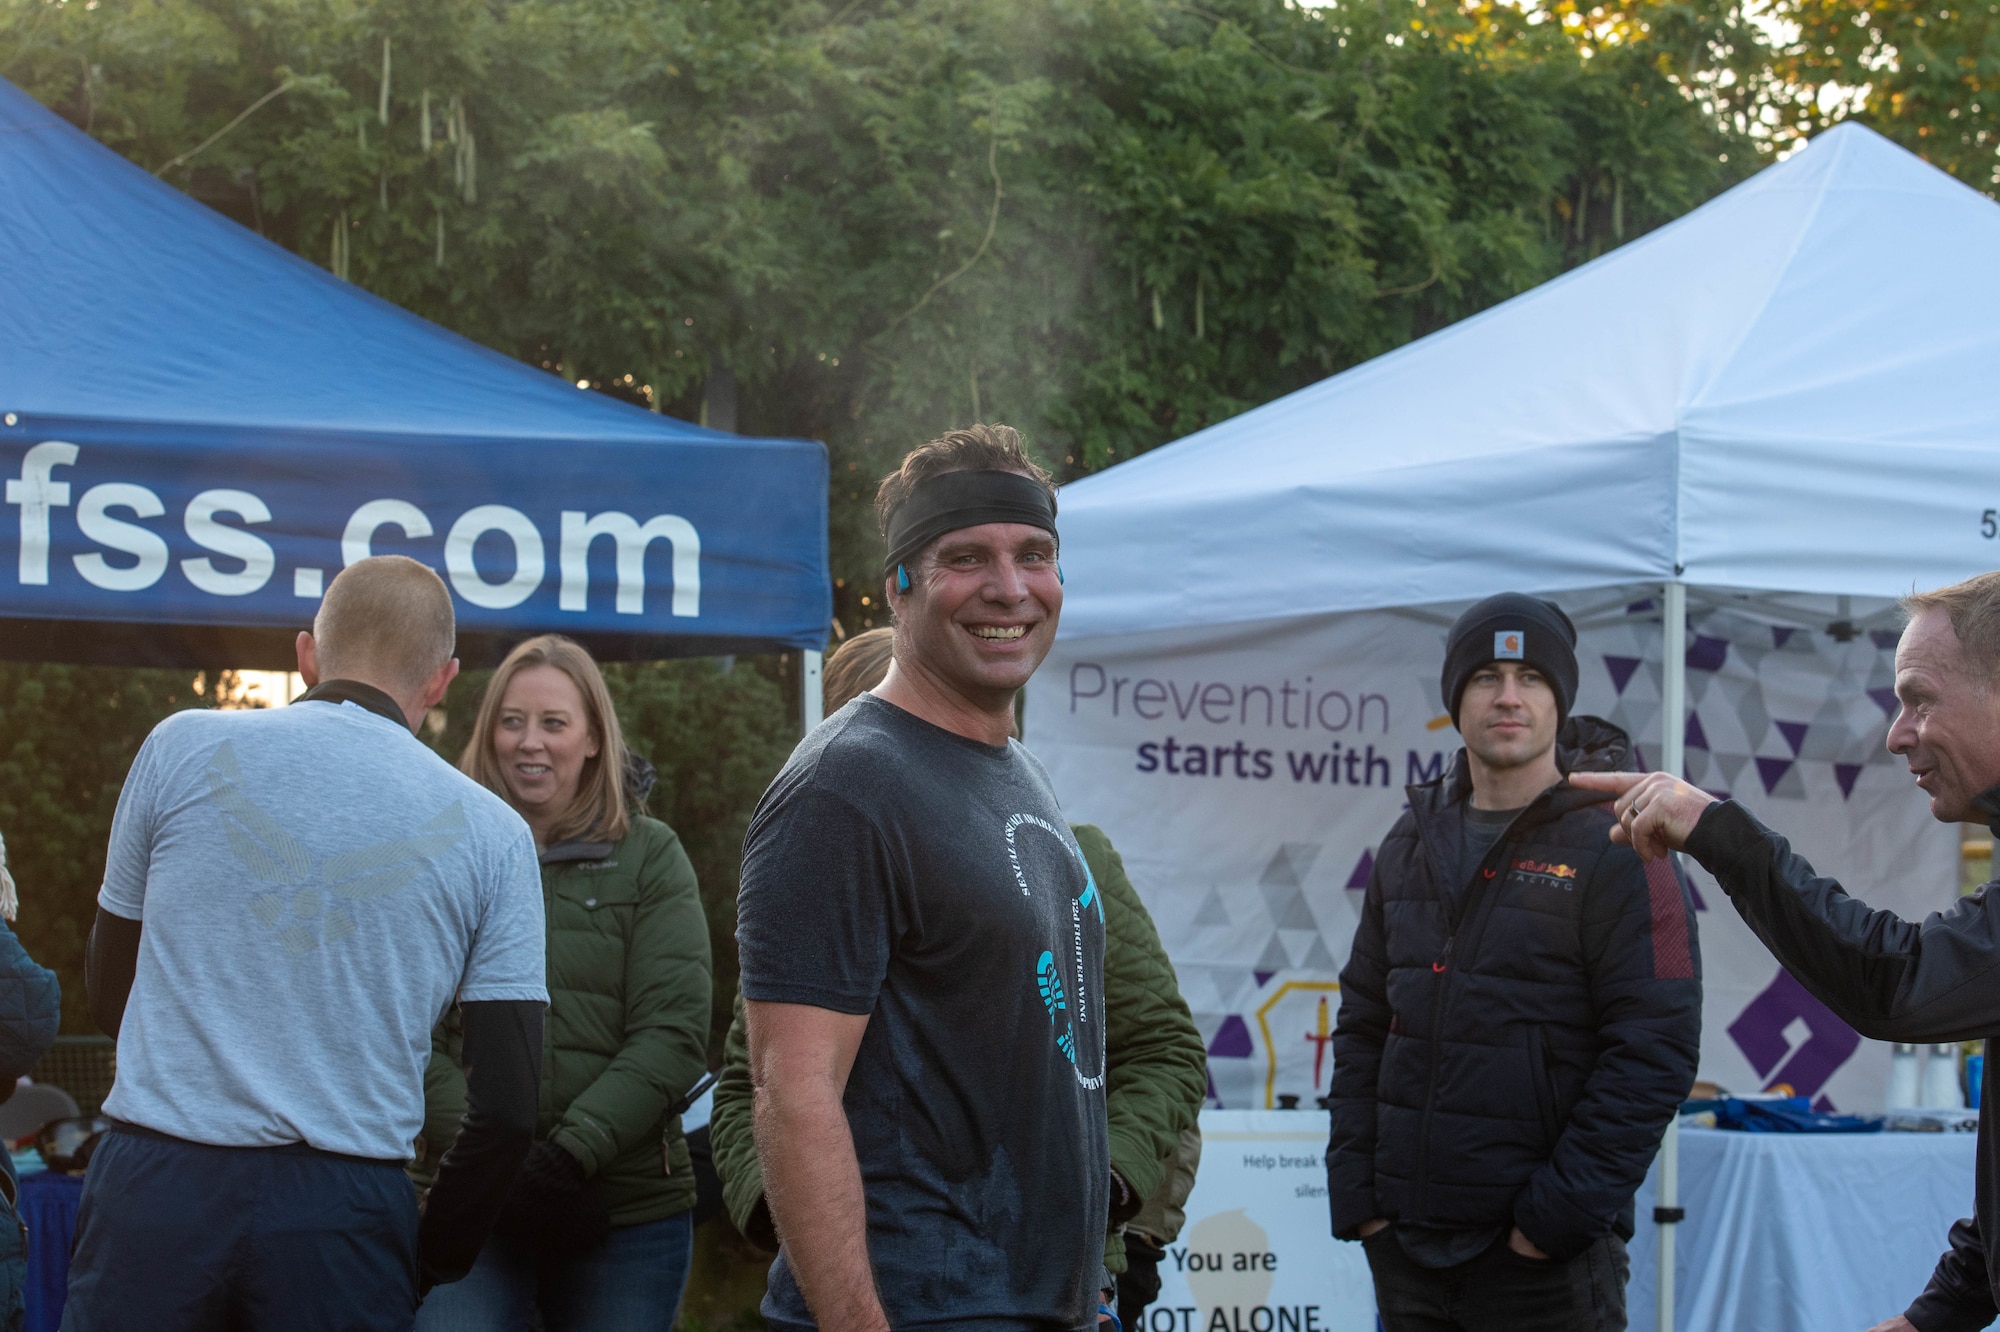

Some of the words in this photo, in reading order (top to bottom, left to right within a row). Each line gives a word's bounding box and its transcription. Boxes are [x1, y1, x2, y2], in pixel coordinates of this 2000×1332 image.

[6, 441, 700, 617] fss.com
[1981, 508, 2000, 540] 5
[1069, 662, 1389, 735] Prevention
[1136, 737, 1273, 781] starts
[1286, 741, 1391, 788] with
[1407, 749, 1452, 786] M
[1007, 847, 1031, 896] SEXUAL
[1071, 898, 1081, 922] 52d
[1073, 923, 1084, 983] FIGHTER
[1078, 986, 1086, 1023] WING
[1243, 1154, 1276, 1171] Help
[1279, 1153, 1319, 1169] break
[1171, 1248, 1223, 1273] You
[1232, 1251, 1278, 1272] are
[1208, 1305, 1331, 1332] ALONE.
